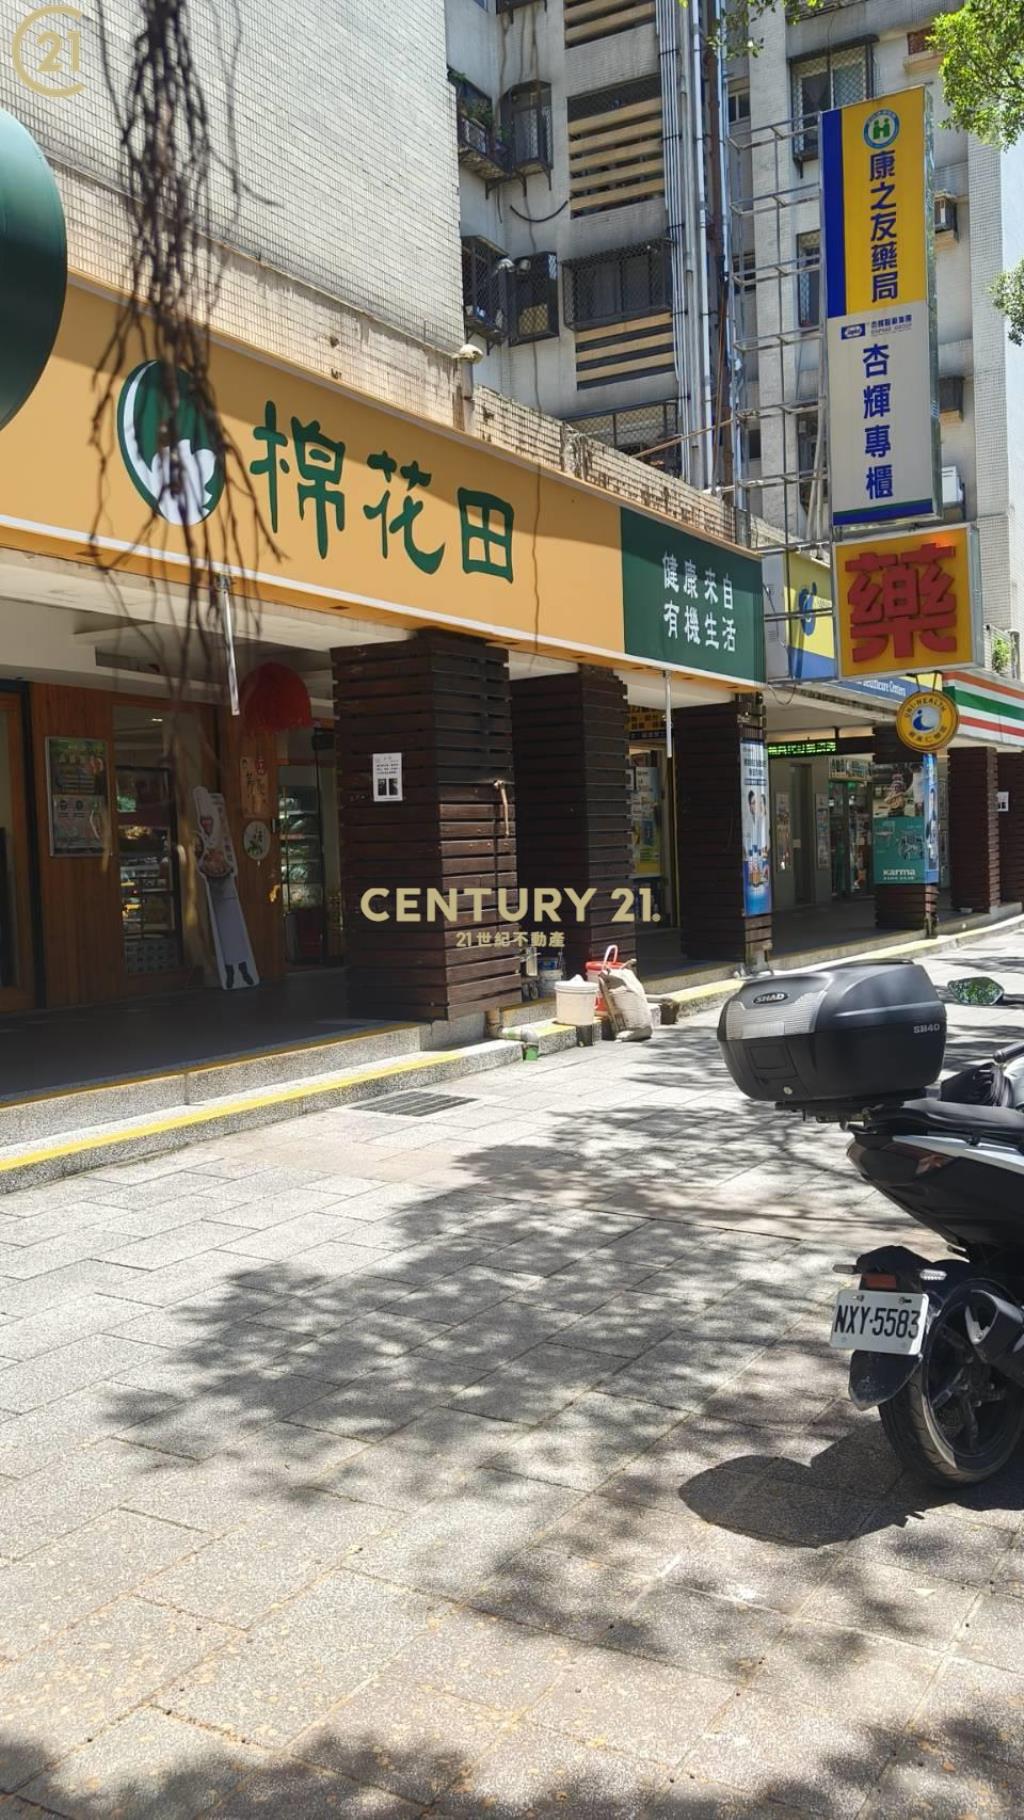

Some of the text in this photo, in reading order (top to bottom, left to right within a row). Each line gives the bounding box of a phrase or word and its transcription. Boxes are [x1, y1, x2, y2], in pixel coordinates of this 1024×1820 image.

[869, 149, 898, 303] 康之友藥局
[862, 343, 894, 500] 杏輝專櫃
[249, 400, 515, 584] 棉花田
[662, 552, 734, 610] 健康來自
[663, 599, 737, 652] 有機生活
[844, 542, 956, 663] 藥
[756, 993, 785, 1003] SHAD
